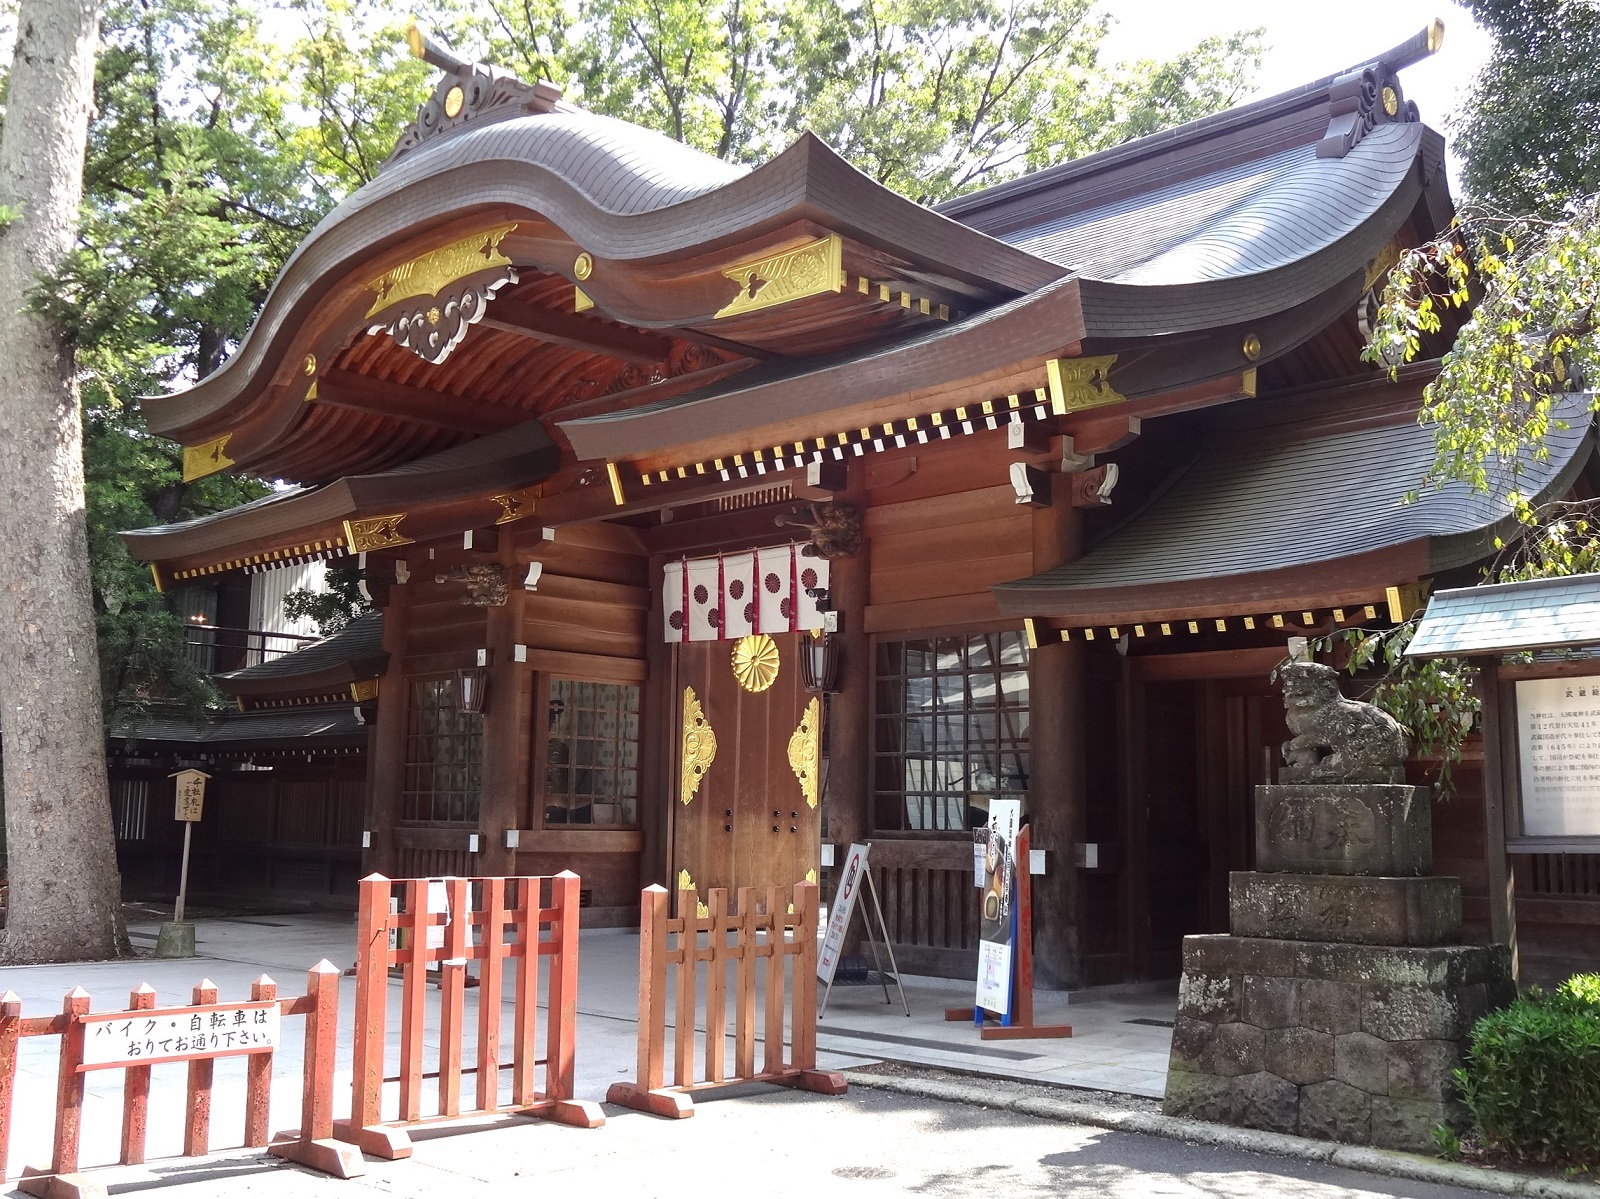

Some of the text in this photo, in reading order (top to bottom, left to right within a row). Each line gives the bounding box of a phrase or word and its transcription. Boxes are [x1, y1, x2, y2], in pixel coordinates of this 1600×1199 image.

[95, 1009, 268, 1037] バイク・自転車は
[127, 1029, 273, 1057] おりてお通り下さい。
